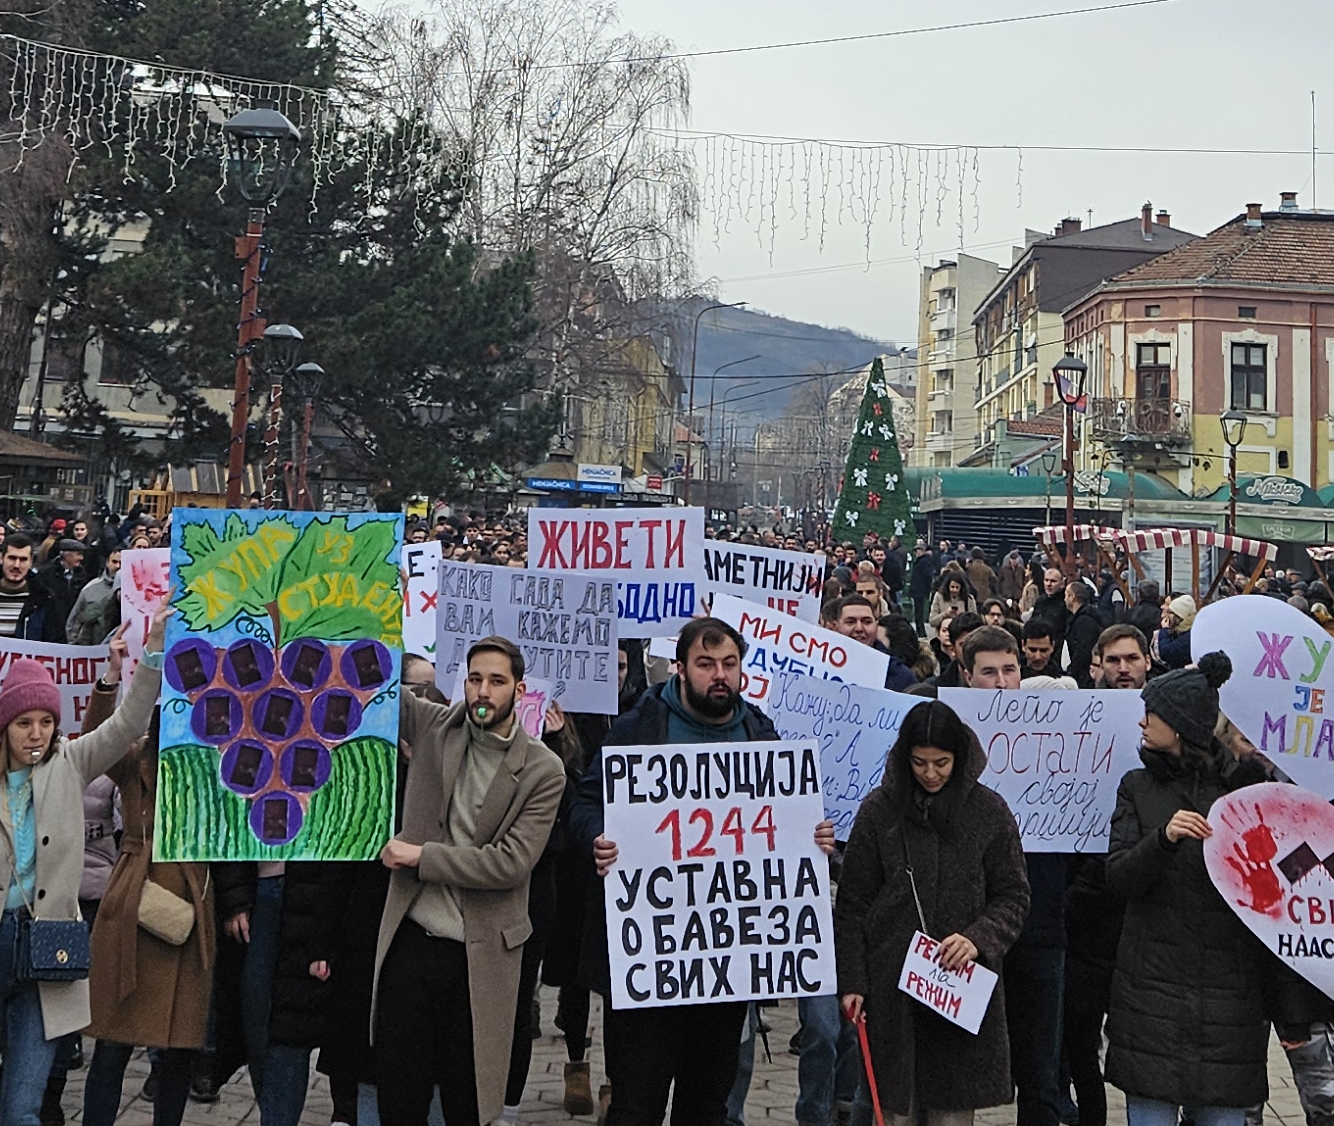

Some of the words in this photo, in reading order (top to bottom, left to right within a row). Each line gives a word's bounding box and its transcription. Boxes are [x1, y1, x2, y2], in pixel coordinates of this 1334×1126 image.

[318, 530, 354, 564] УЗ
[537, 520, 686, 569] ЖИВЕТИ
[185, 525, 294, 620] ЖУПА
[441, 564, 493, 601] КАКО
[510, 574, 564, 610] САДА
[576, 582, 615, 615] ДА
[704, 548, 823, 598] АМЕТНИЈИ
[444, 603, 496, 635] ВАМ
[518, 610, 610, 646] КАЖЕМО
[739, 612, 782, 645] МИ
[789, 632, 847, 668] СМО
[519, 647, 610, 682] УТИТЕ
[1079, 696, 1104, 732] је
[1293, 685, 1325, 714] ЈЕ
[605, 749, 819, 804] РЕЗОЛУЦИЈА
[655, 805, 776, 860] 1244
[616, 857, 820, 912] УСТАВНА
[622, 905, 822, 956] ОБАВЕЗА
[626, 956, 735, 1002] СВИХ
[750, 948, 821, 994] НАС
[906, 971, 962, 1019] РЕЖИМ
